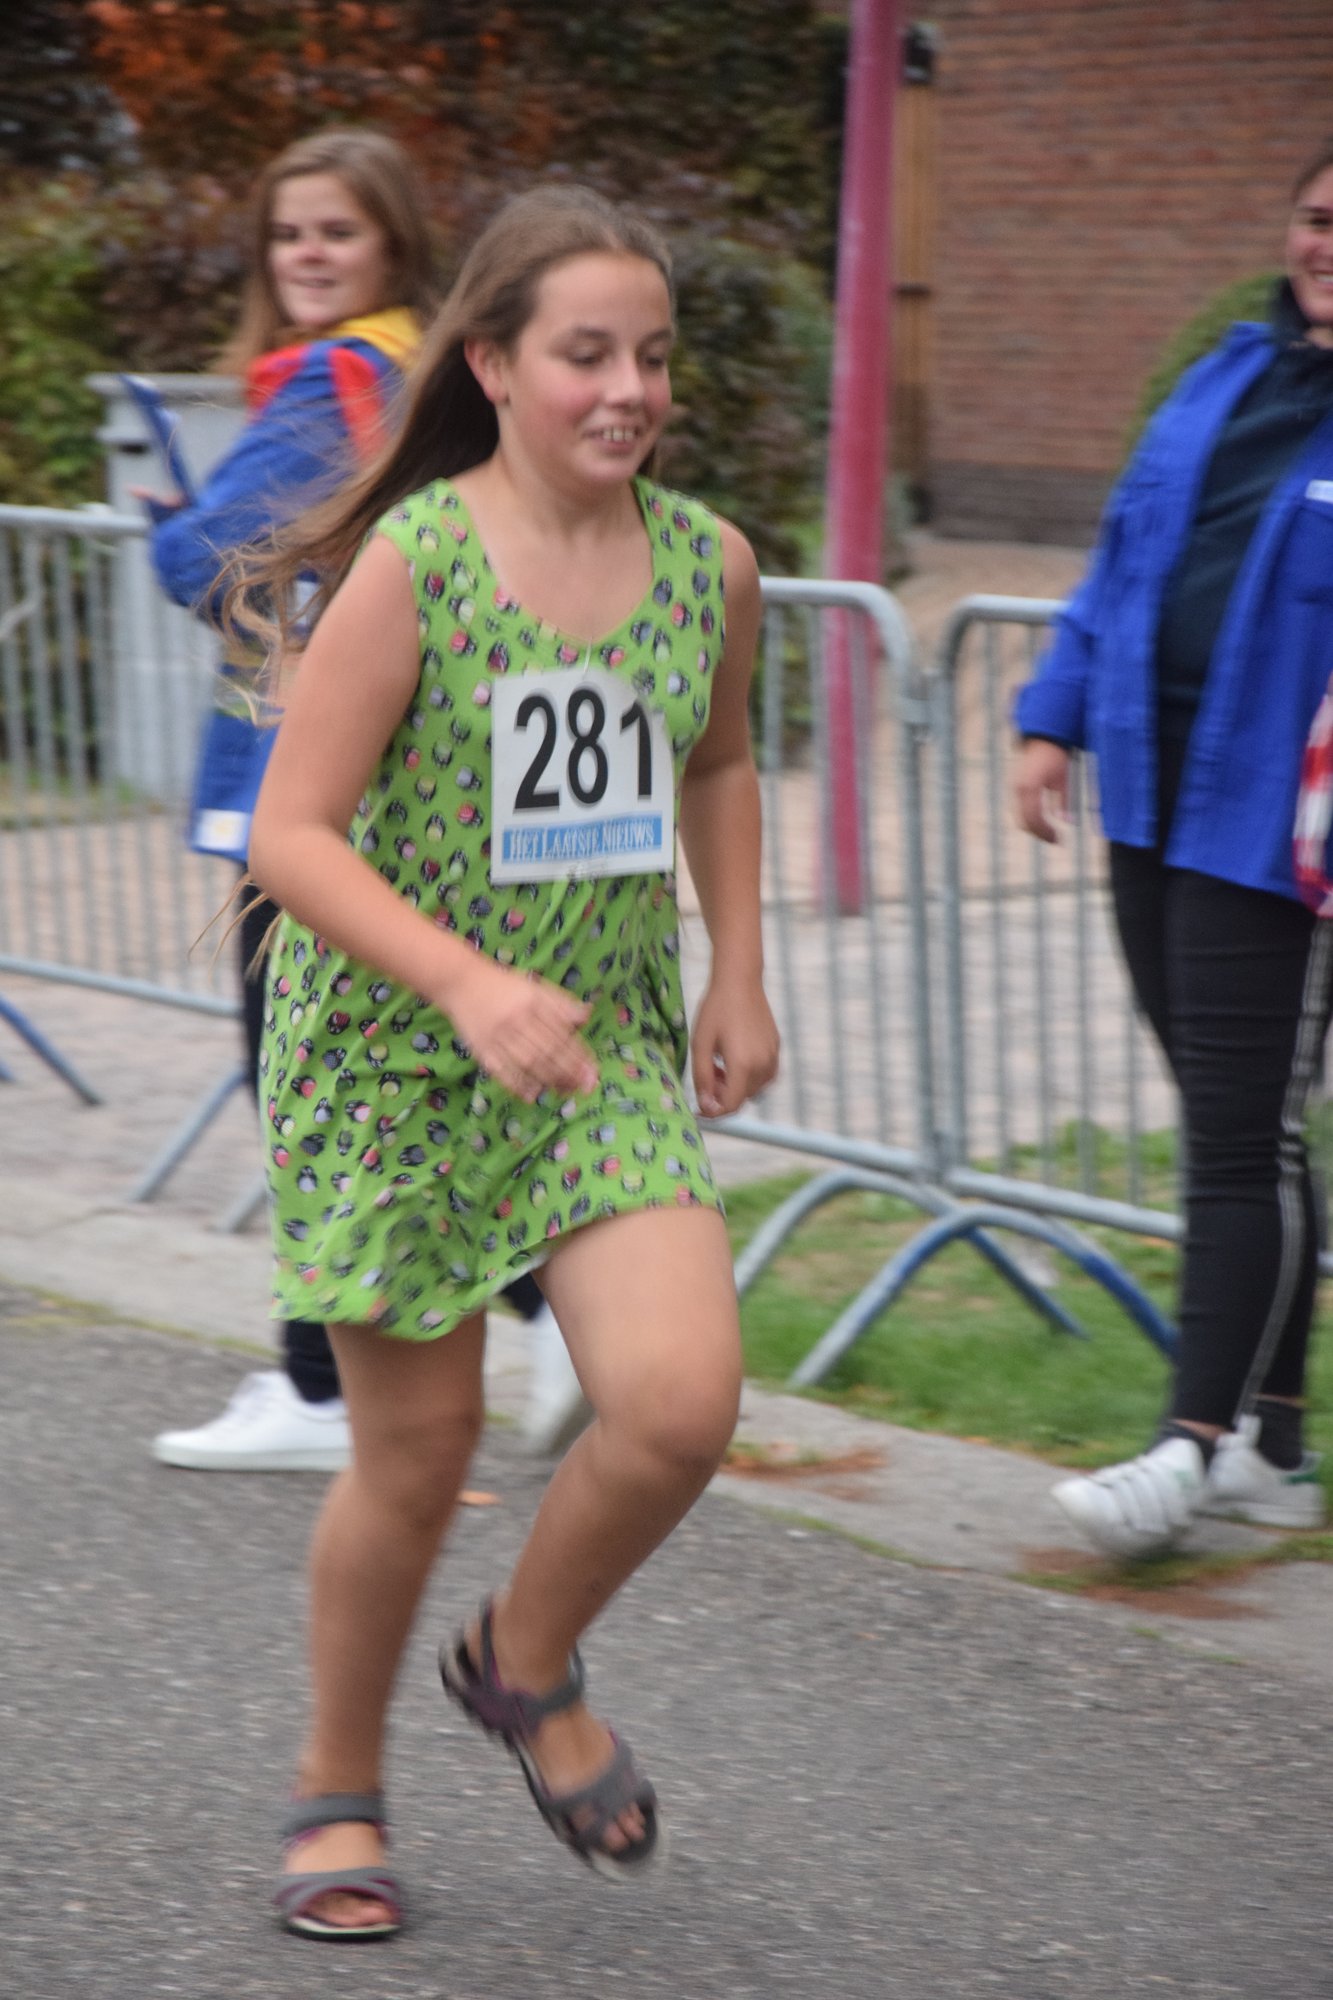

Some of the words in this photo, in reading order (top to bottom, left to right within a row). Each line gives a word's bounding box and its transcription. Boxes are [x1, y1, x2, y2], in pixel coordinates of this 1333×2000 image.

[514, 686, 653, 811] 281
[511, 829, 540, 862] HET
[541, 823, 600, 860] LAATSTE
[601, 818, 655, 853] NIEUWS
